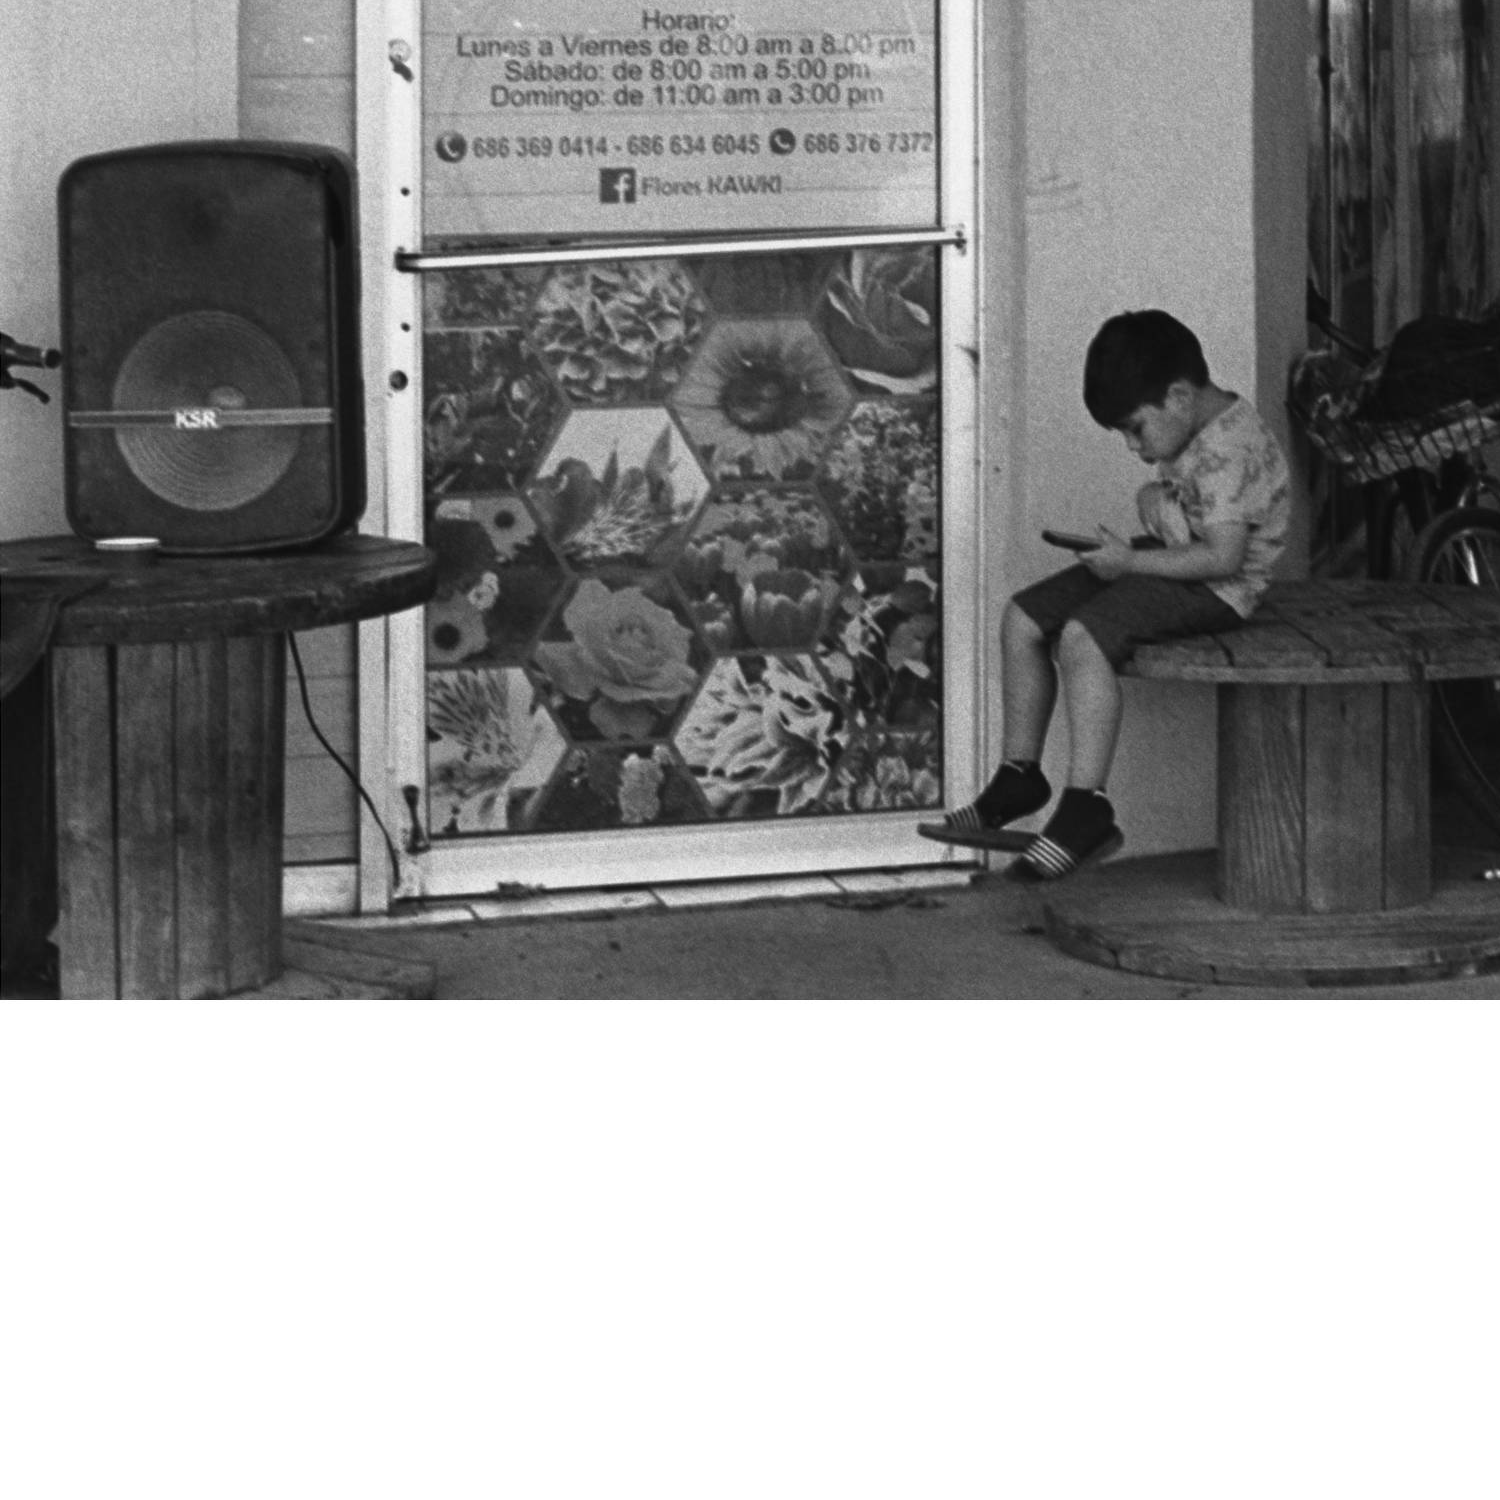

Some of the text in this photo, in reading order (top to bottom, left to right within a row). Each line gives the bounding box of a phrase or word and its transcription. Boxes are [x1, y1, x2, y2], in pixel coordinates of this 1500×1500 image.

[456, 35, 531, 58] Lunes
[538, 39, 554, 57] a
[560, 34, 653, 57] Viernes
[658, 34, 690, 56] de
[696, 33, 749, 56] 8:00
[754, 37, 793, 55] am
[799, 37, 815, 55] a
[878, 37, 916, 59] pm
[612, 59, 644, 82] de
[650, 58, 702, 82] 8:00
[710, 62, 748, 81] am
[753, 61, 769, 81] a
[775, 58, 827, 81] 5:00
[833, 61, 871, 84] pm
[489, 83, 884, 112] Domingo: de 11:00 am a 3:00 pm
[472, 136, 511, 158] 686
[515, 135, 553, 158] 369
[559, 135, 608, 157] 0414
[627, 133, 666, 156] 686
[669, 133, 706, 156] 634
[712, 132, 761, 156] 6045
[803, 131, 934, 155] 686 376 7372
[707, 173, 781, 195] KAWKI
